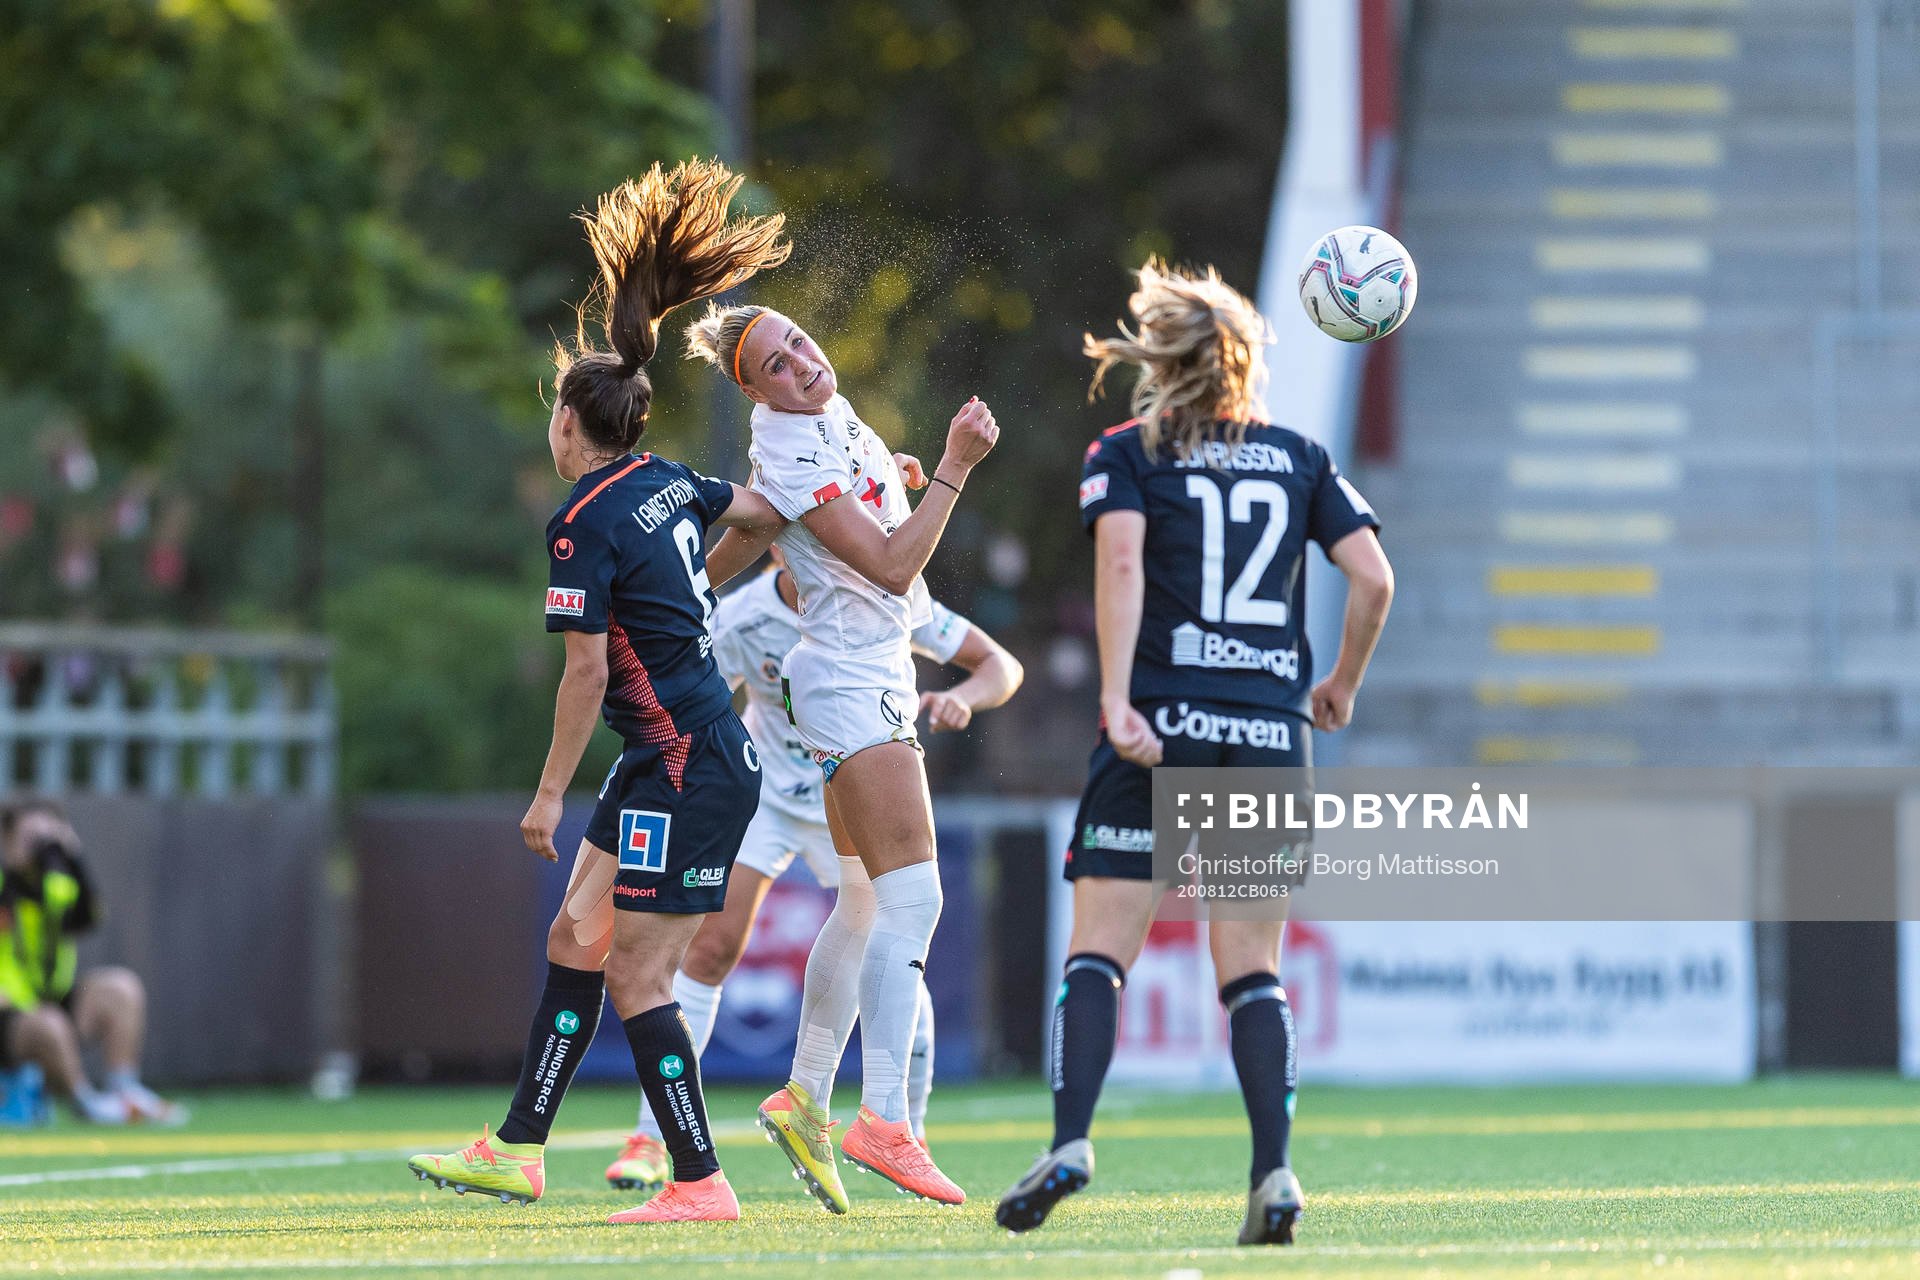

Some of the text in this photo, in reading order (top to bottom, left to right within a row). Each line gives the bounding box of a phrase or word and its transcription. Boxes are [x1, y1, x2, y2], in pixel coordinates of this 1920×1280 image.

[1185, 475, 1290, 627] 12
[1155, 702, 1292, 751] Corren
[614, 884, 657, 898] uhlsport
[534, 1033, 556, 1082] FASTIGHETER
[534, 1038, 571, 1115] LUNDBERGS
[664, 1083, 687, 1132] FASTIGHETER
[675, 1080, 708, 1152] LUNDBERGS
